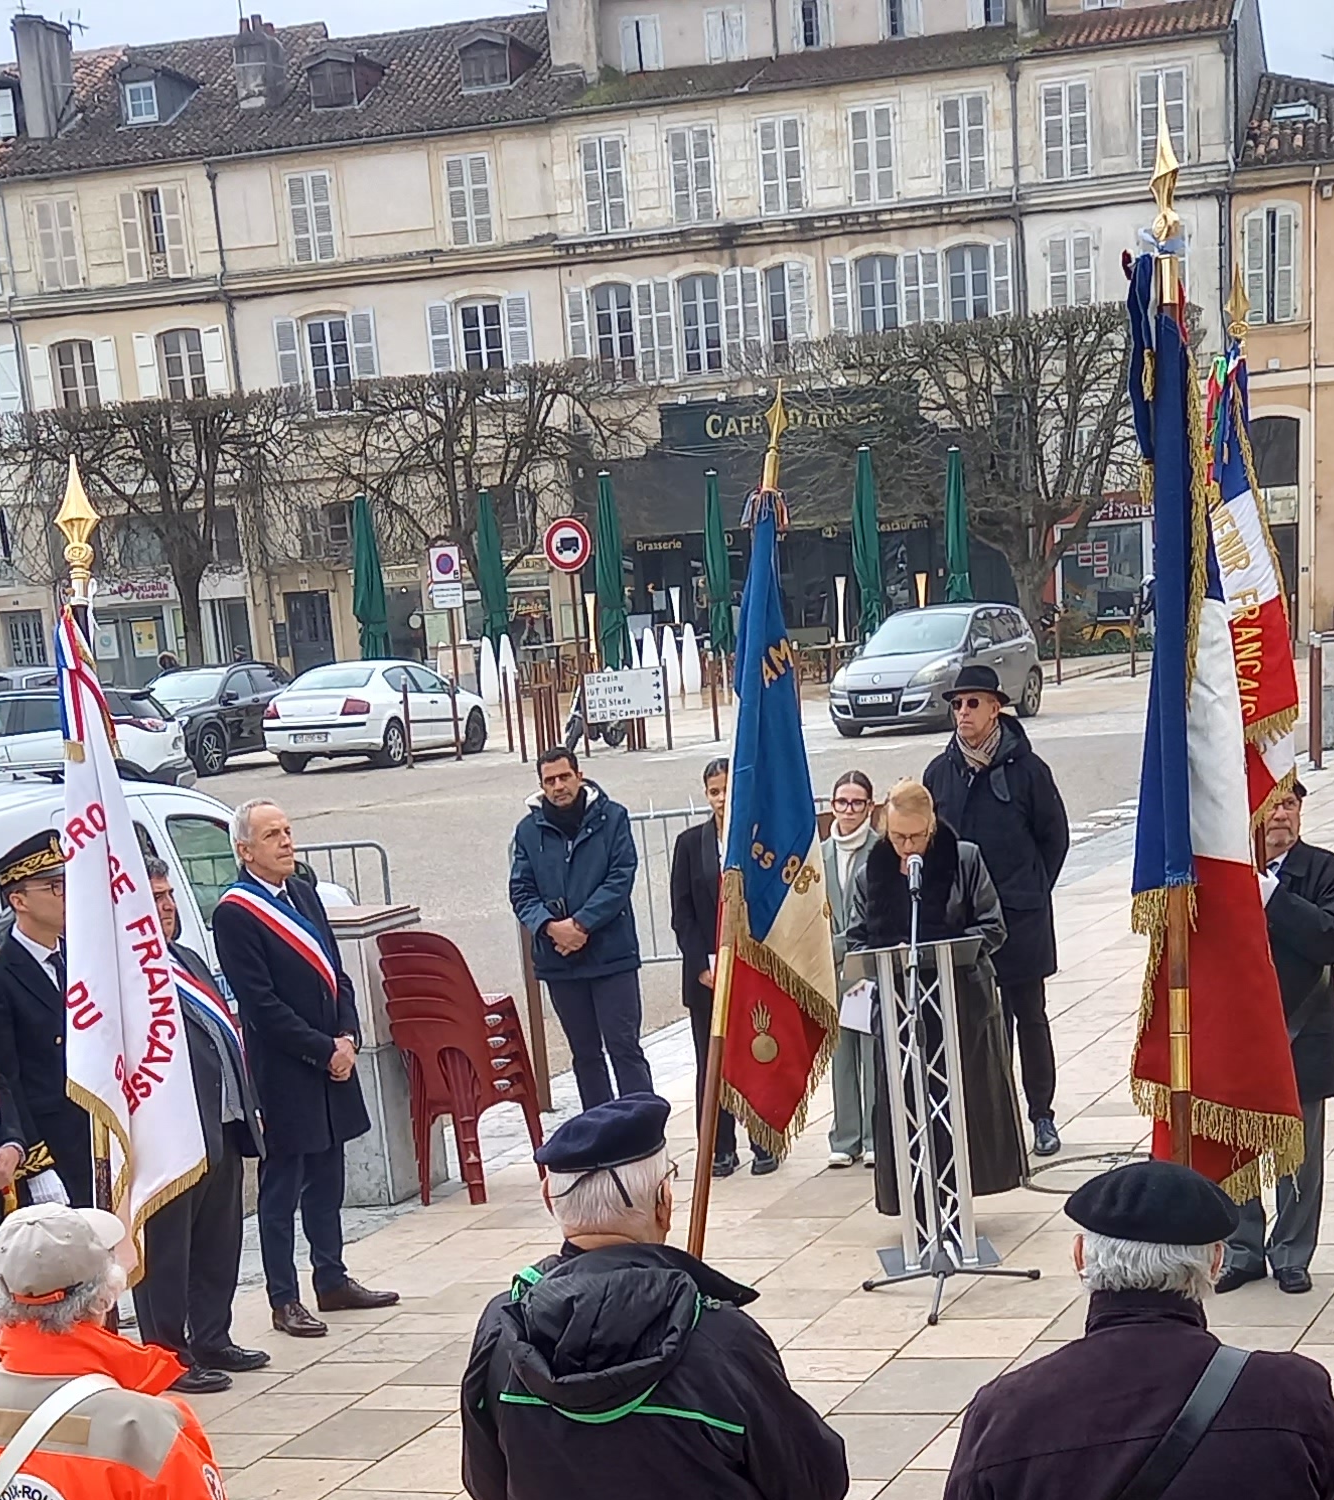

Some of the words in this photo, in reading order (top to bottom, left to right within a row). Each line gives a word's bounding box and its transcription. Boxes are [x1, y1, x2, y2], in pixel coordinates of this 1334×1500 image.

[635, 538, 682, 552] Brasserie
[608, 698, 631, 706] Stade
[618, 706, 653, 717] Camping
